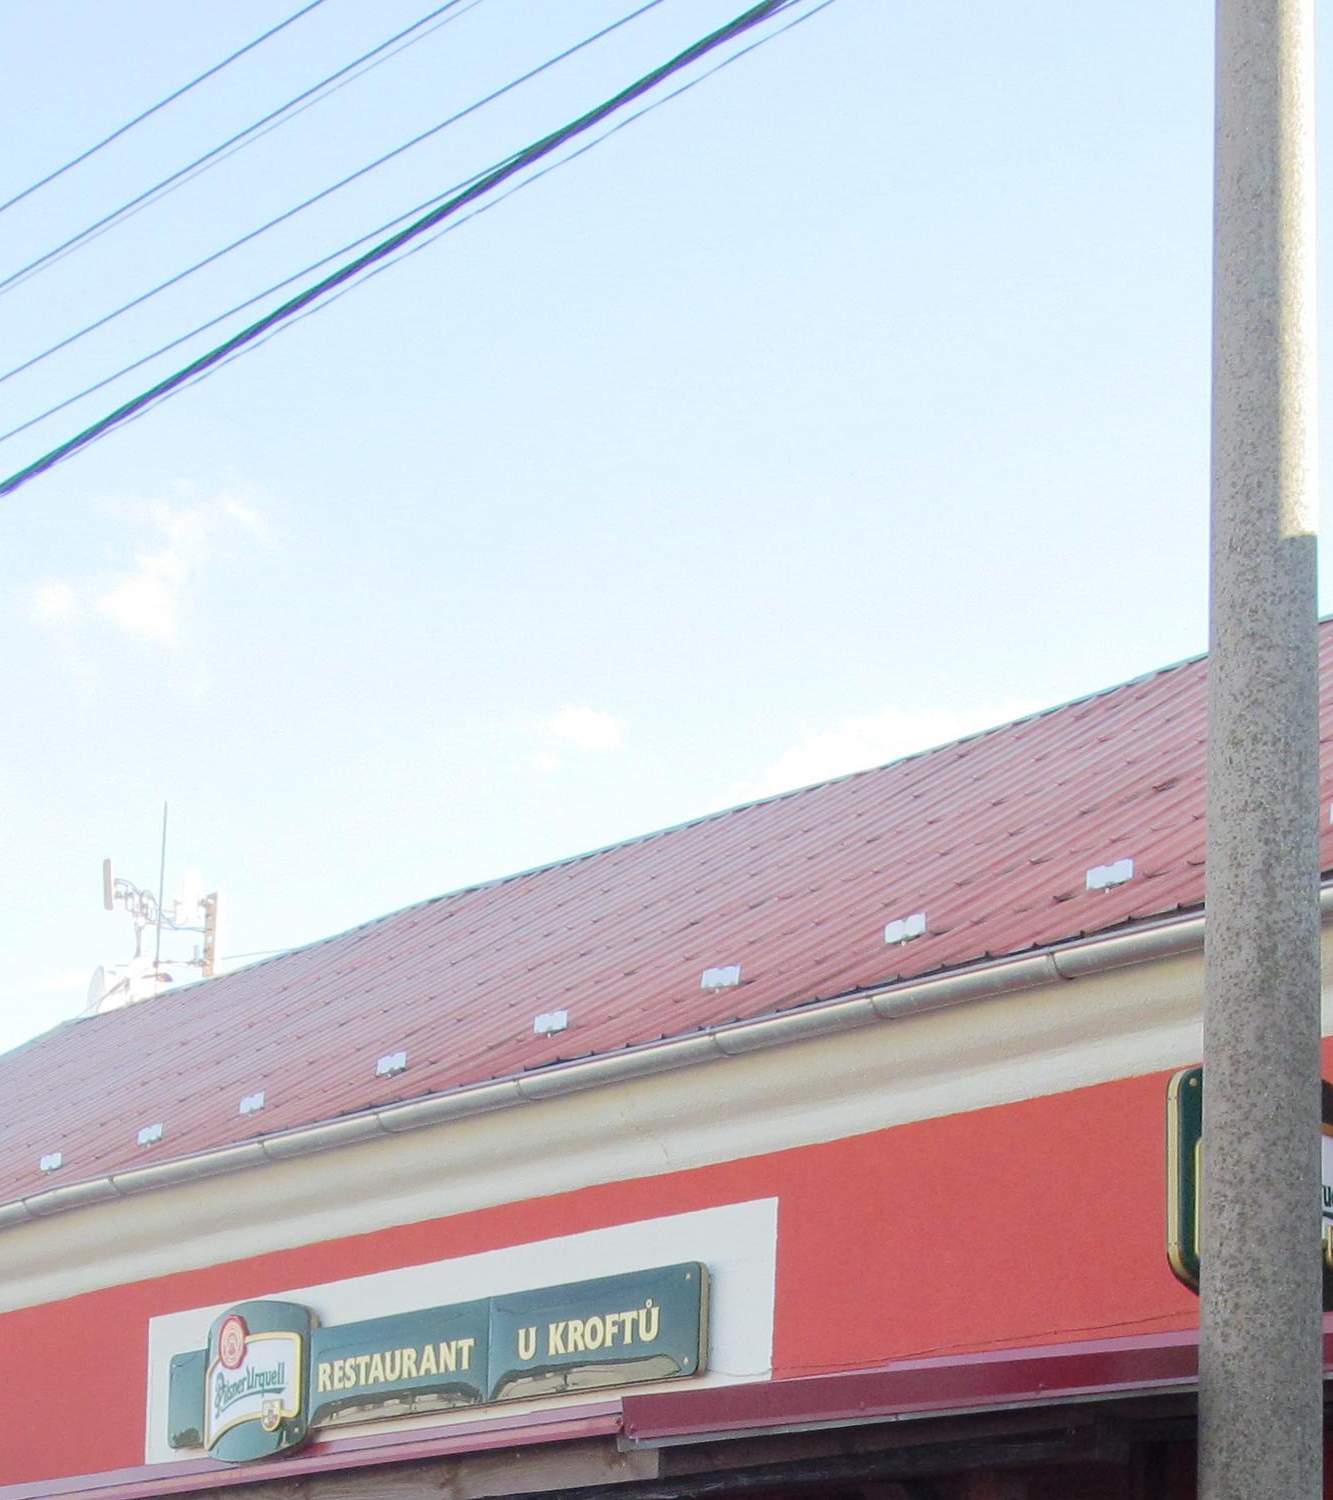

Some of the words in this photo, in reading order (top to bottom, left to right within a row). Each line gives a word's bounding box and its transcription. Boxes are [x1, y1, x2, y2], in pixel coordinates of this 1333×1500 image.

[317, 1337, 475, 1393] RESTAURANT
[518, 1326, 538, 1361] U
[548, 1298, 660, 1356] KROFTŮ
[215, 1371, 247, 1411] Pilsner
[246, 1362, 285, 1397] Urquell
